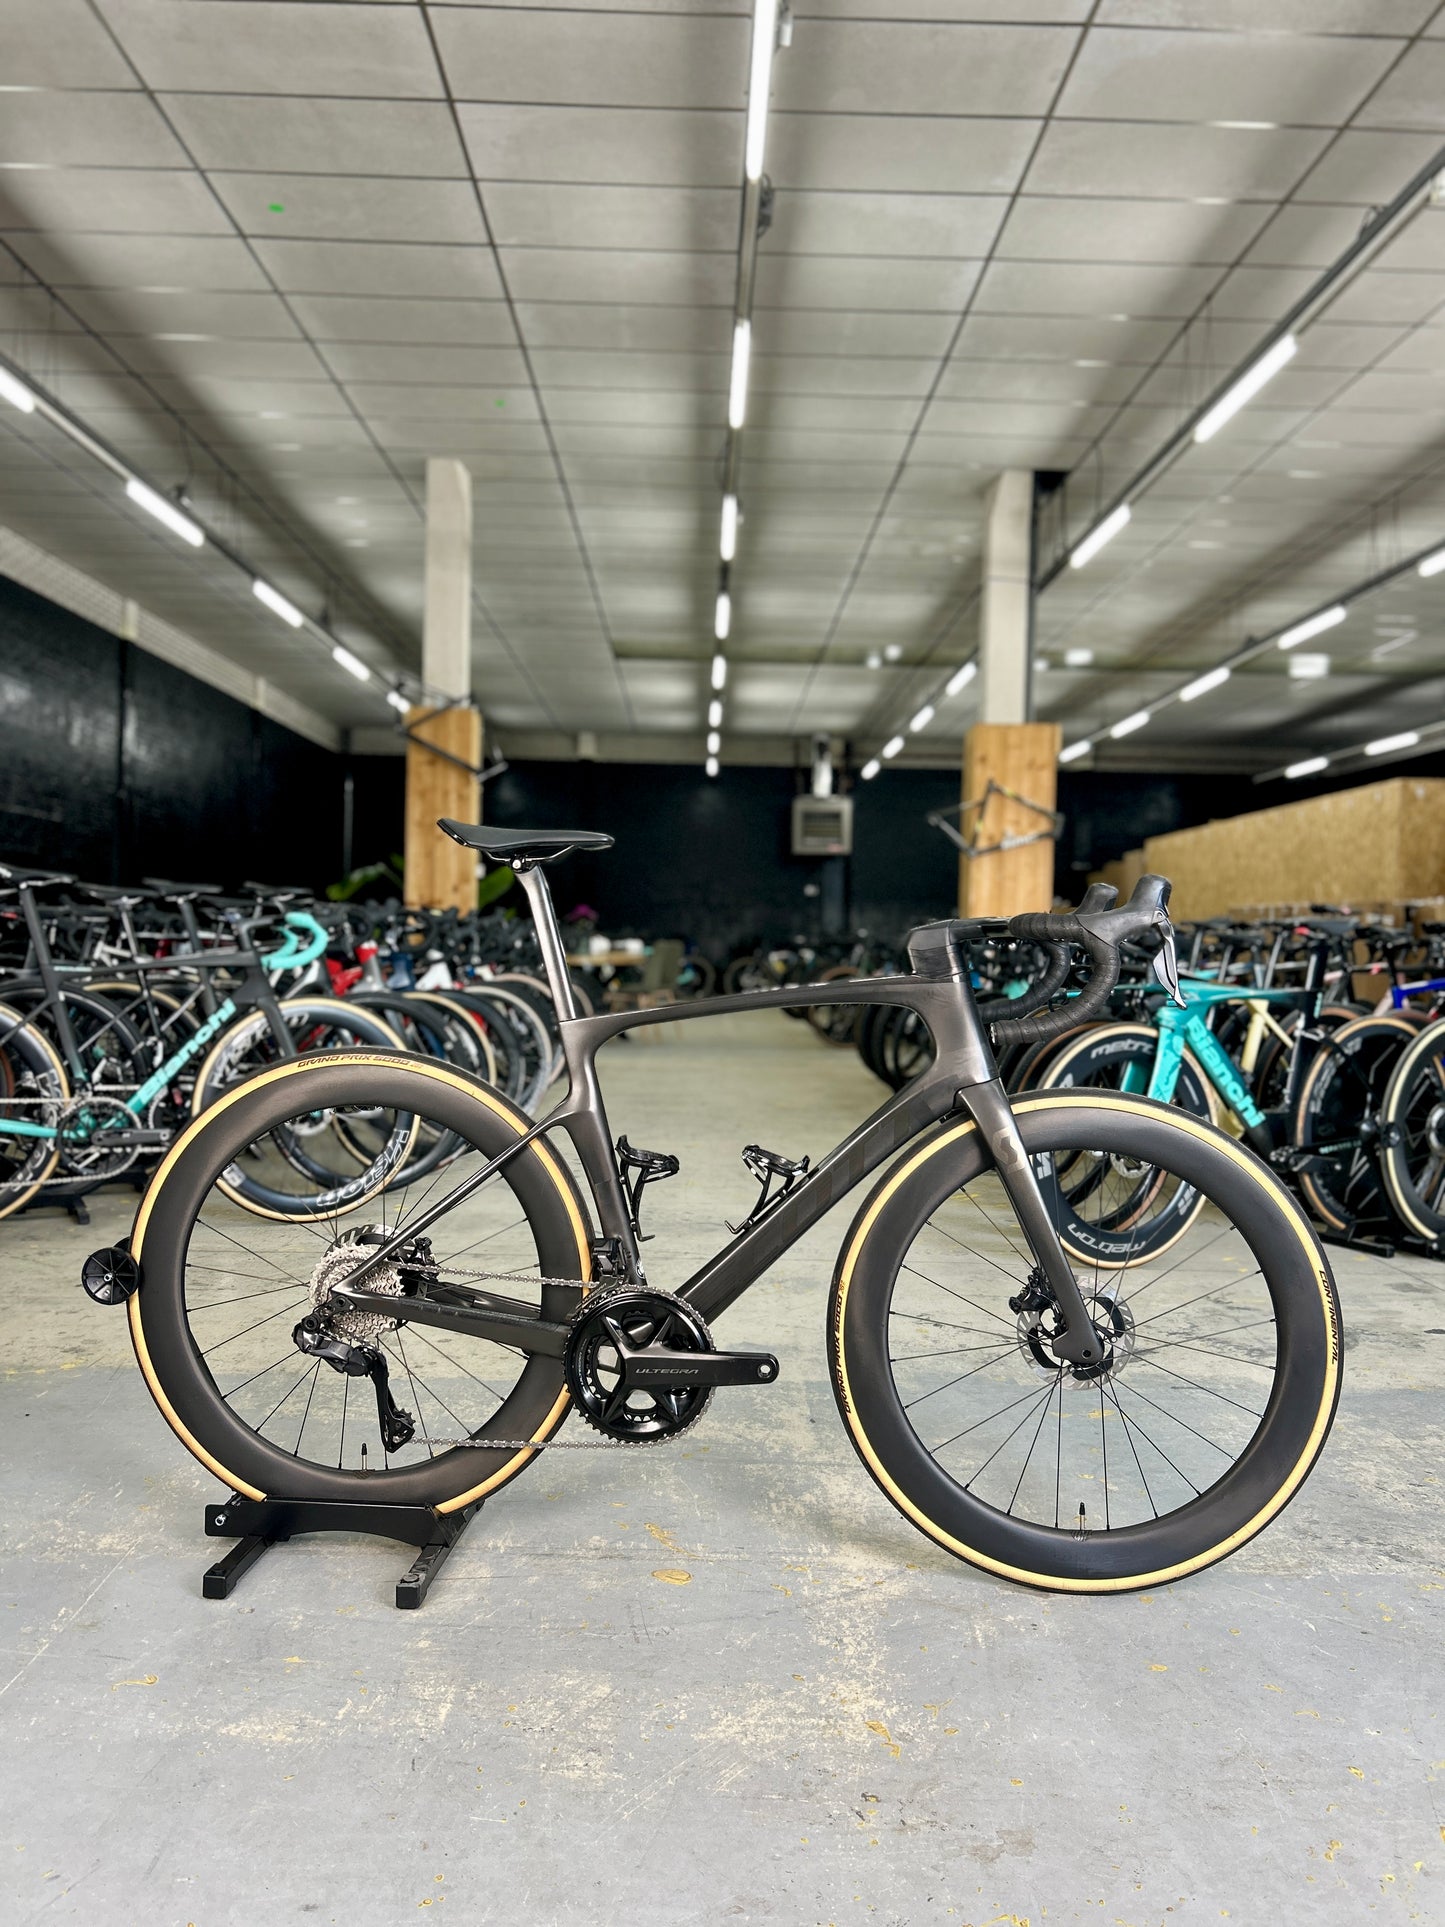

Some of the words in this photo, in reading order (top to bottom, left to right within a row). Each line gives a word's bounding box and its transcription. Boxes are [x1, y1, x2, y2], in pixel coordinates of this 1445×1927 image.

[136, 997, 237, 1106] Bianchi
[297, 1055, 339, 1068] GRAND
[372, 1055, 410, 1065] 5000
[1090, 1038, 1154, 1059] metro
[1186, 1014, 1266, 1128] Bianchi
[1067, 1223, 1147, 1253] metron
[834, 1295, 843, 1333] 5000
[1319, 1270, 1338, 1365] CONTINENTAL
[836, 1369, 851, 1414] GRAND
